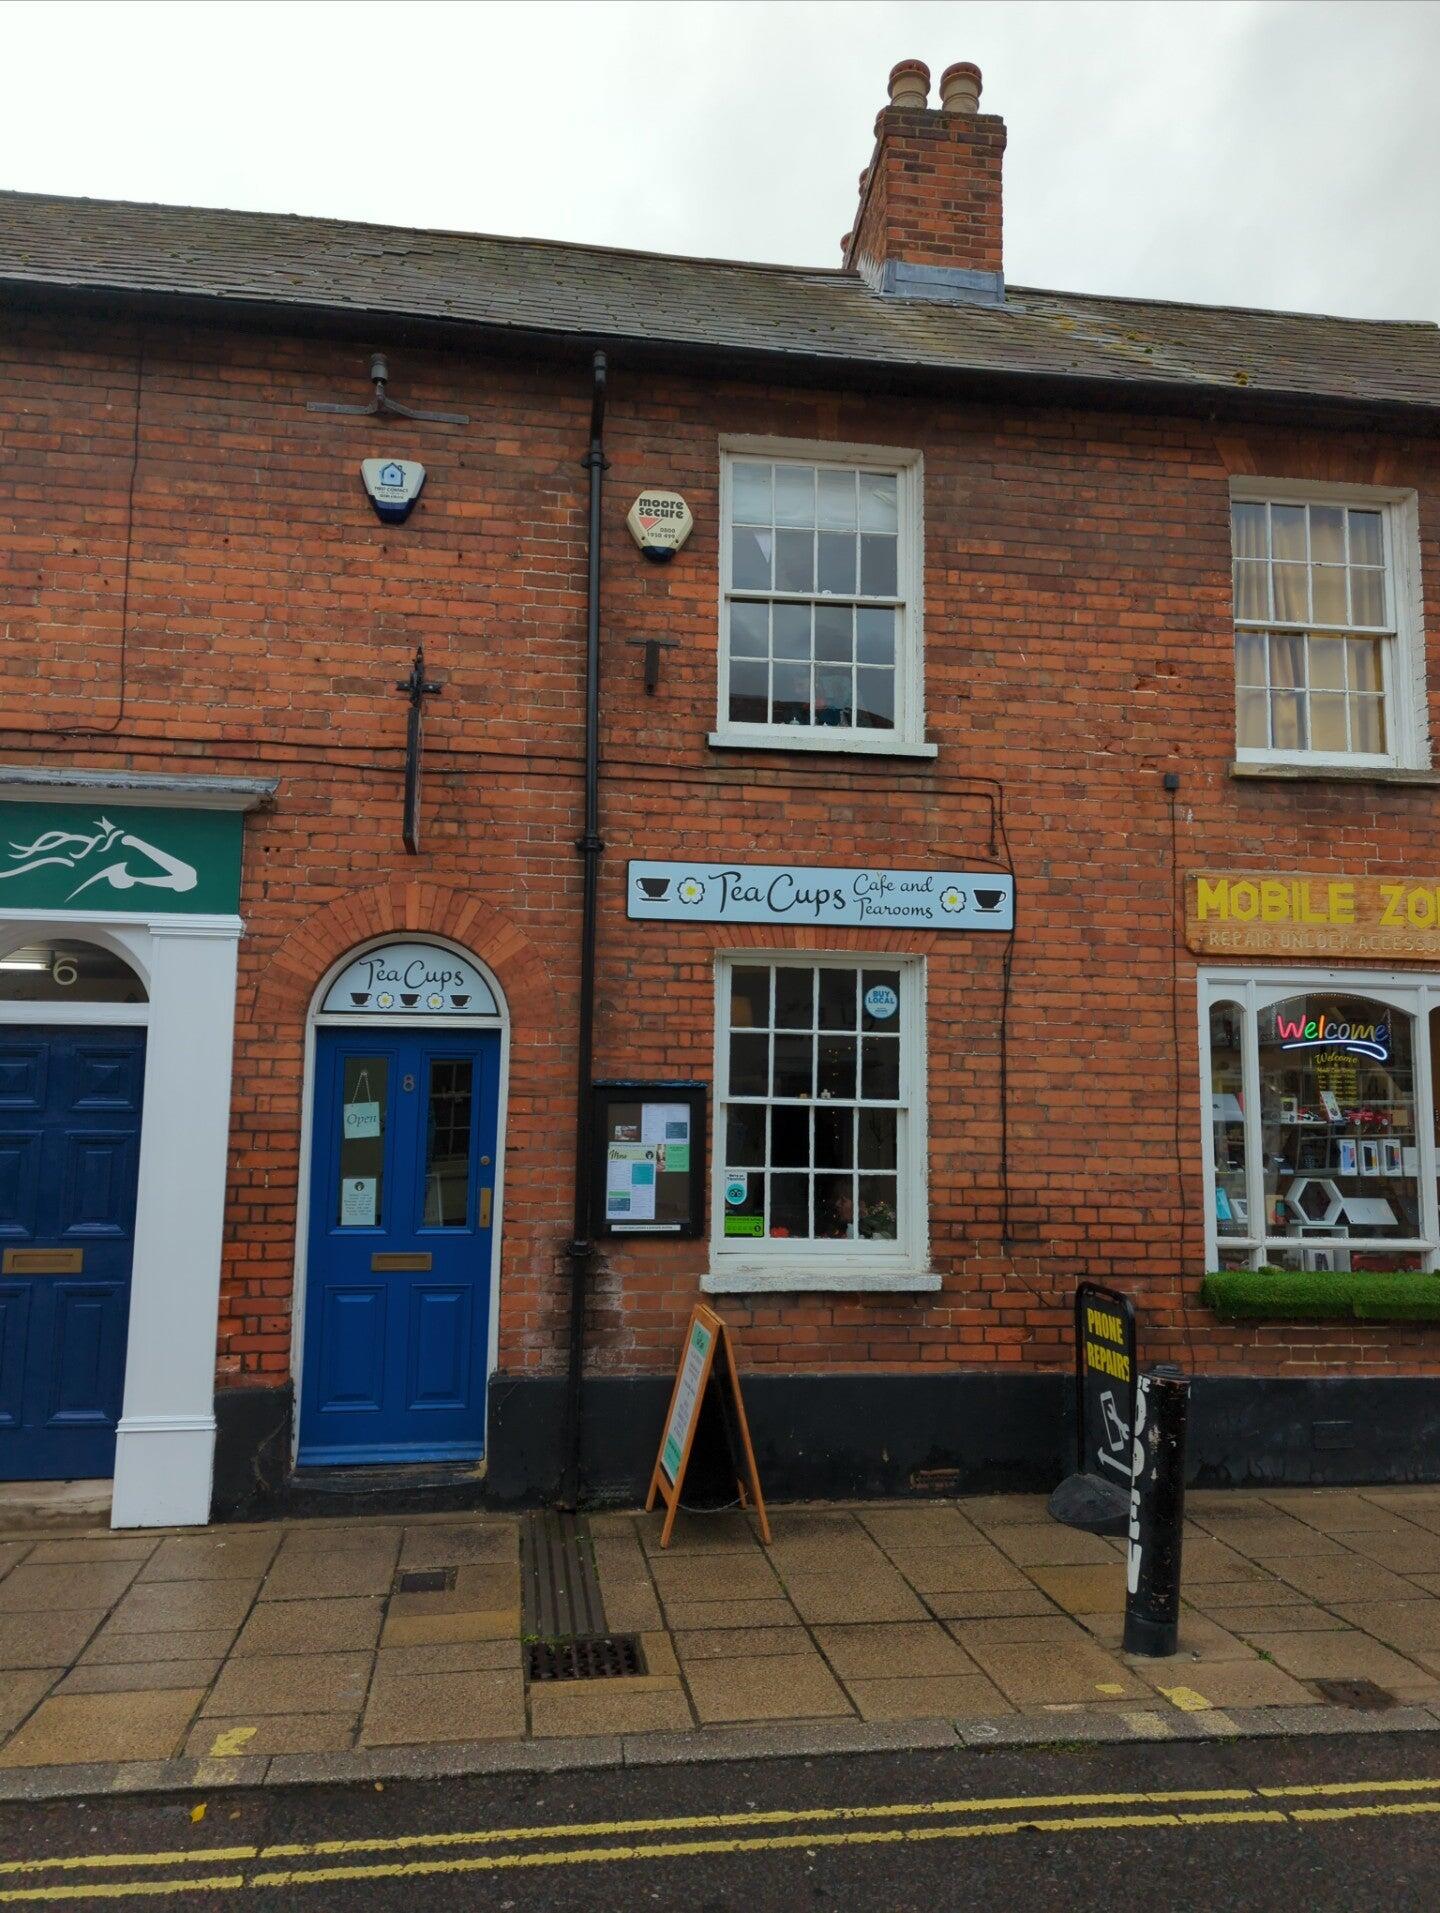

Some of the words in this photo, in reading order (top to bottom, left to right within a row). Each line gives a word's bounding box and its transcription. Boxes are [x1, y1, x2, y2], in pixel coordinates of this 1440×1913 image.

[638, 507, 684, 519] secure
[639, 498, 684, 510] moore
[900, 876, 934, 893] and
[853, 897, 934, 921] Tearooms
[1197, 878, 1355, 924] MOBILE
[1209, 931, 1271, 947] REPAIR
[1358, 935, 1440, 951] ACCESSO
[52, 956, 78, 986] 6
[1277, 1014, 1389, 1042] Welcome
[403, 1074, 416, 1092] 8
[346, 1112, 377, 1127] Open
[1086, 1307, 1124, 1345] PHONE
[1086, 1341, 1130, 1382] REPAIRS
